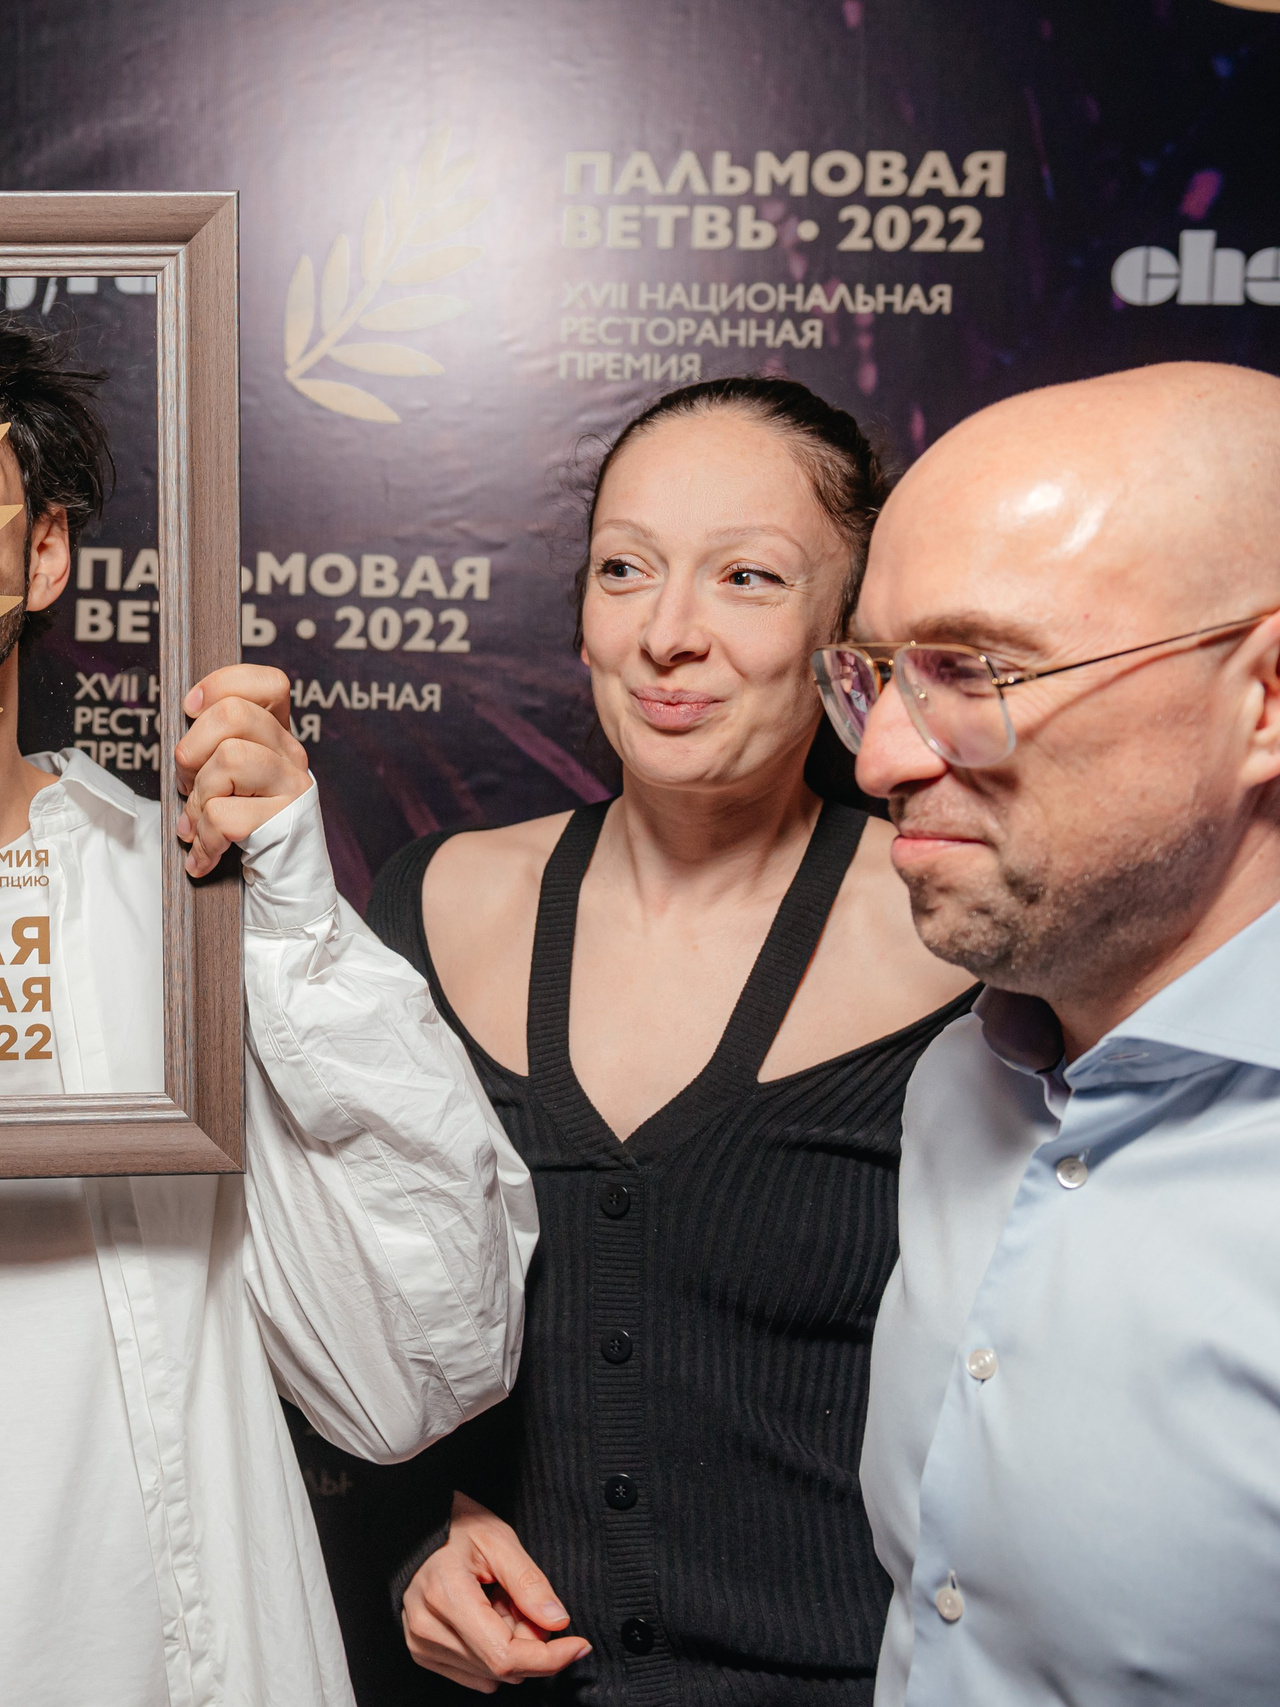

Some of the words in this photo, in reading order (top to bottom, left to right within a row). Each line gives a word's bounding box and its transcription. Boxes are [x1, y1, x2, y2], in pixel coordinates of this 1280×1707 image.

[564, 150, 1007, 197] ПАЛЬМОВАЯ
[563, 204, 778, 250] ВЕТВЬ
[837, 204, 984, 252] 2022
[562, 282, 628, 310] XVII
[639, 282, 952, 314] НАЦИОНАЛЬНАЯ
[560, 316, 823, 348] РЕСТОРАННАЯ
[558, 351, 701, 381] ПРЕМИЯ
[77, 547, 491, 599] ПАМОВАЯ
[75, 598, 277, 646] ВЕЬ
[334, 605, 470, 653] 2022
[74, 671, 138, 702] XVII
[75, 740, 160, 771] ПРЕМ
